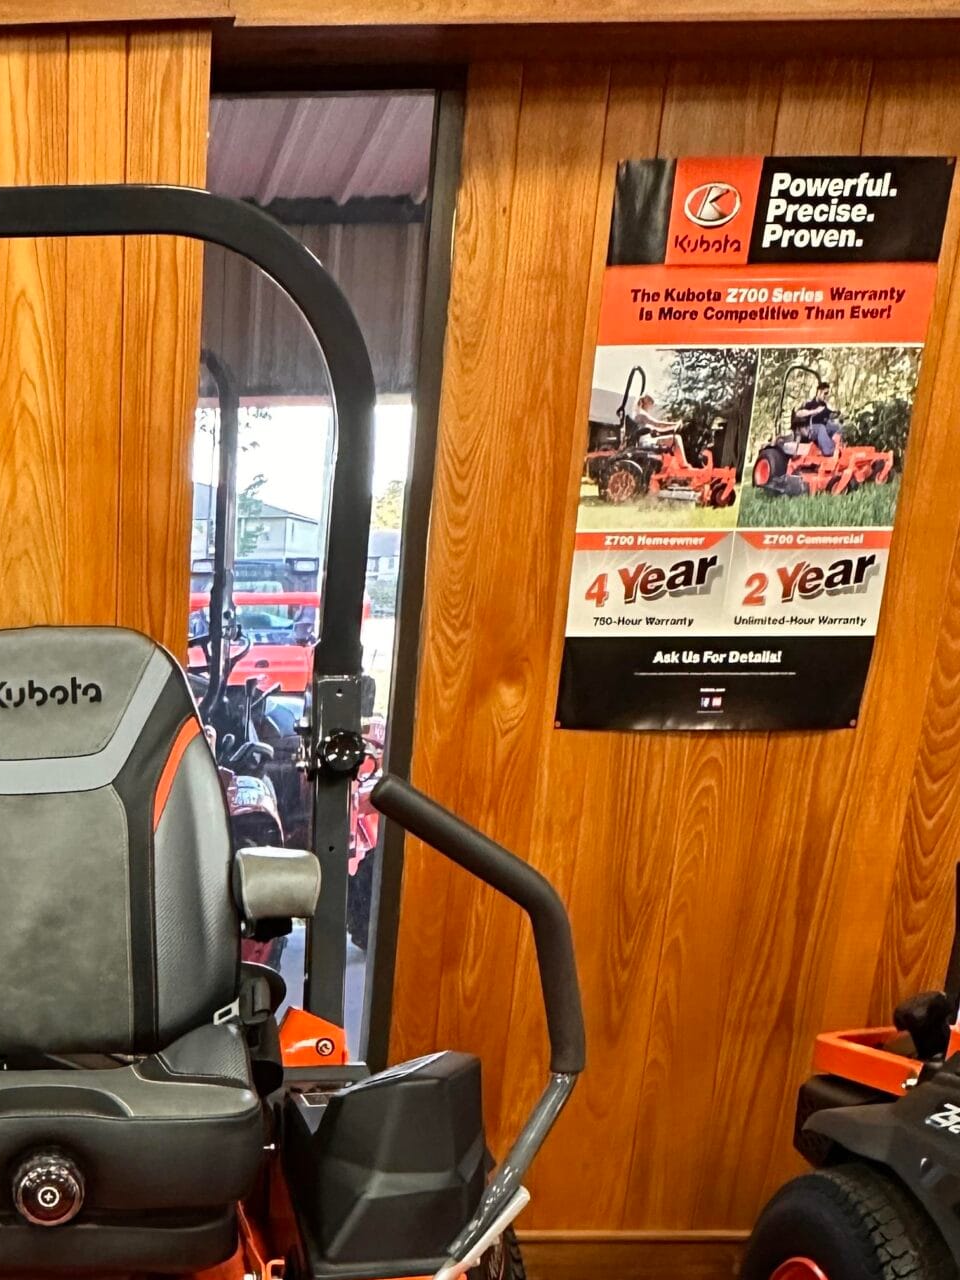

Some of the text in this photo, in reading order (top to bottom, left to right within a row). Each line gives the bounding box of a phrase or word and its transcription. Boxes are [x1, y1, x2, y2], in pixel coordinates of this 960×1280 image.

[770, 172, 898, 197] Powerful.
[766, 198, 875, 223] Precise.
[675, 233, 741, 253] Kubota
[762, 223, 864, 248] Proven.
[631, 286, 906, 303] The Kubota Z700 Series Warranty
[639, 304, 892, 324] Is More Competitive Than Ever!
[604, 535, 705, 546] Z700 Homeowner
[763, 533, 864, 545] Z700 Commercial
[585, 554, 720, 608] 4 Year
[742, 553, 878, 606] 2 Year
[645, 616, 694, 627] Warranty
[734, 615, 867, 627] Unlimited-Hour Warranty
[652, 650, 782, 664] Ask Us For Details!
